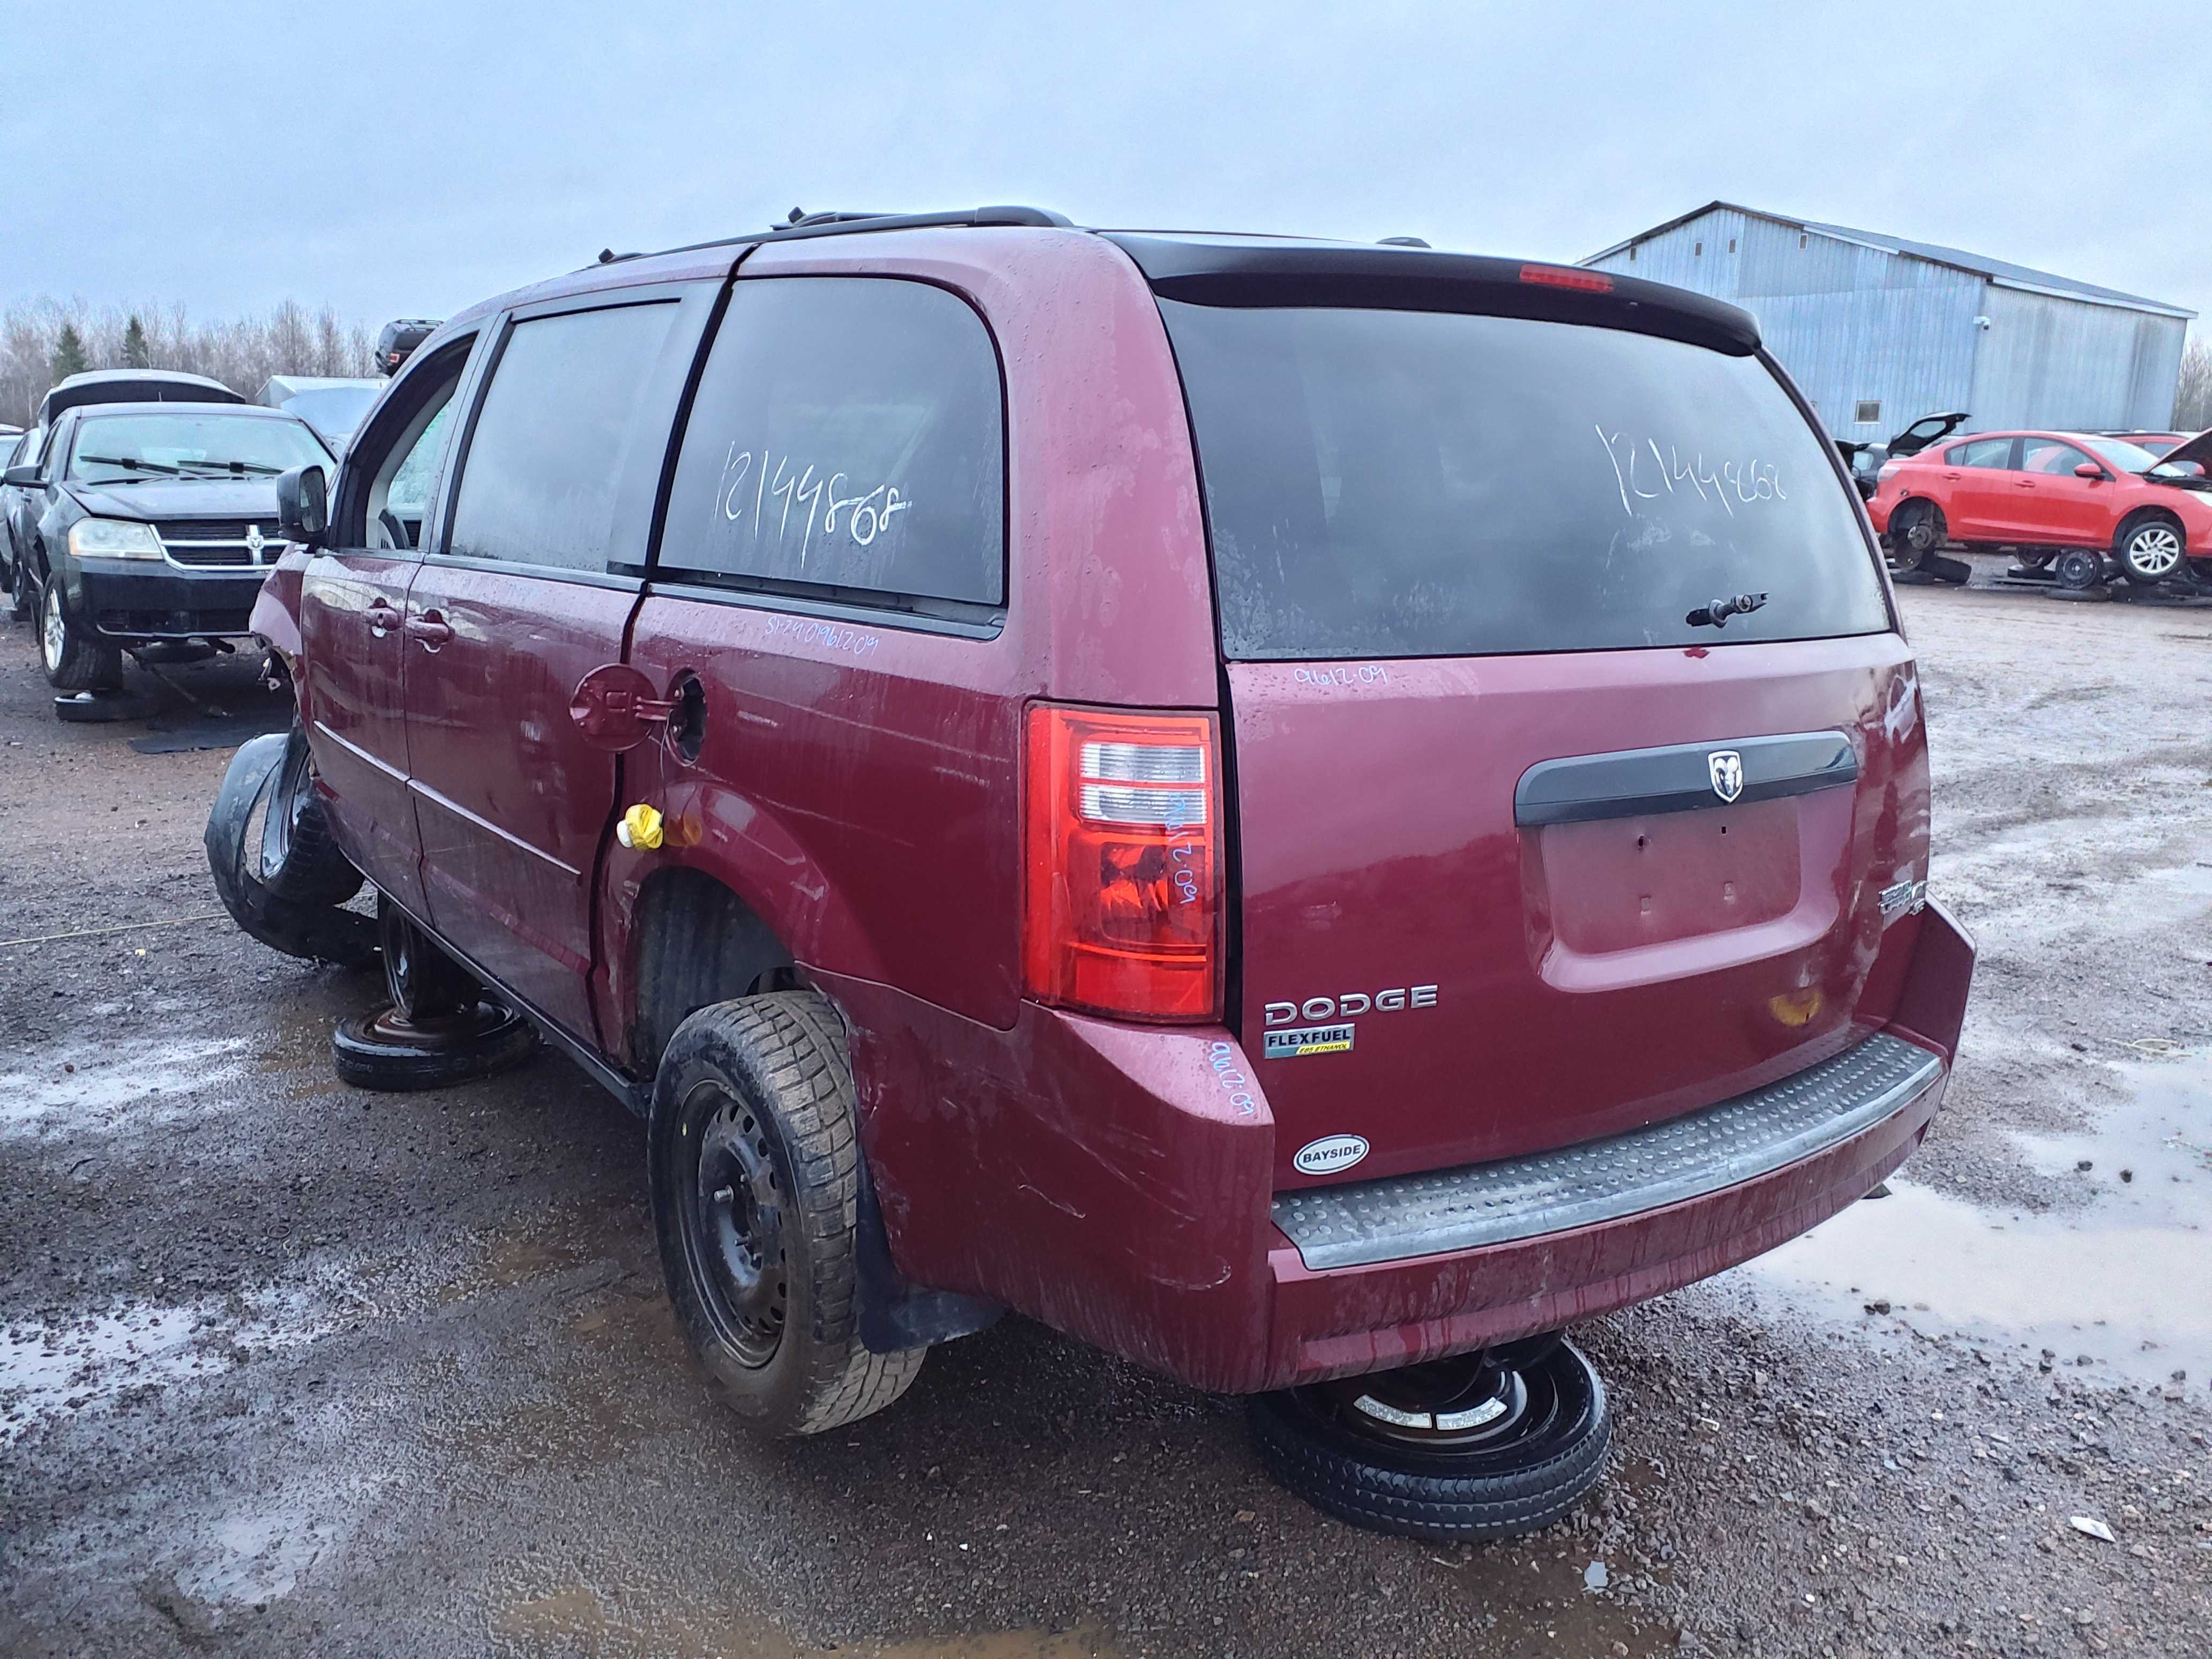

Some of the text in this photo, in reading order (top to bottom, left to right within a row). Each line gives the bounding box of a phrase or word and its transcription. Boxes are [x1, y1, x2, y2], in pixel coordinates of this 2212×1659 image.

[1265, 984, 1438, 1026] DODGE
[1268, 1029, 1350, 1047] FLEXFUEL
[1303, 1144, 1362, 1163] BAYSIDE
